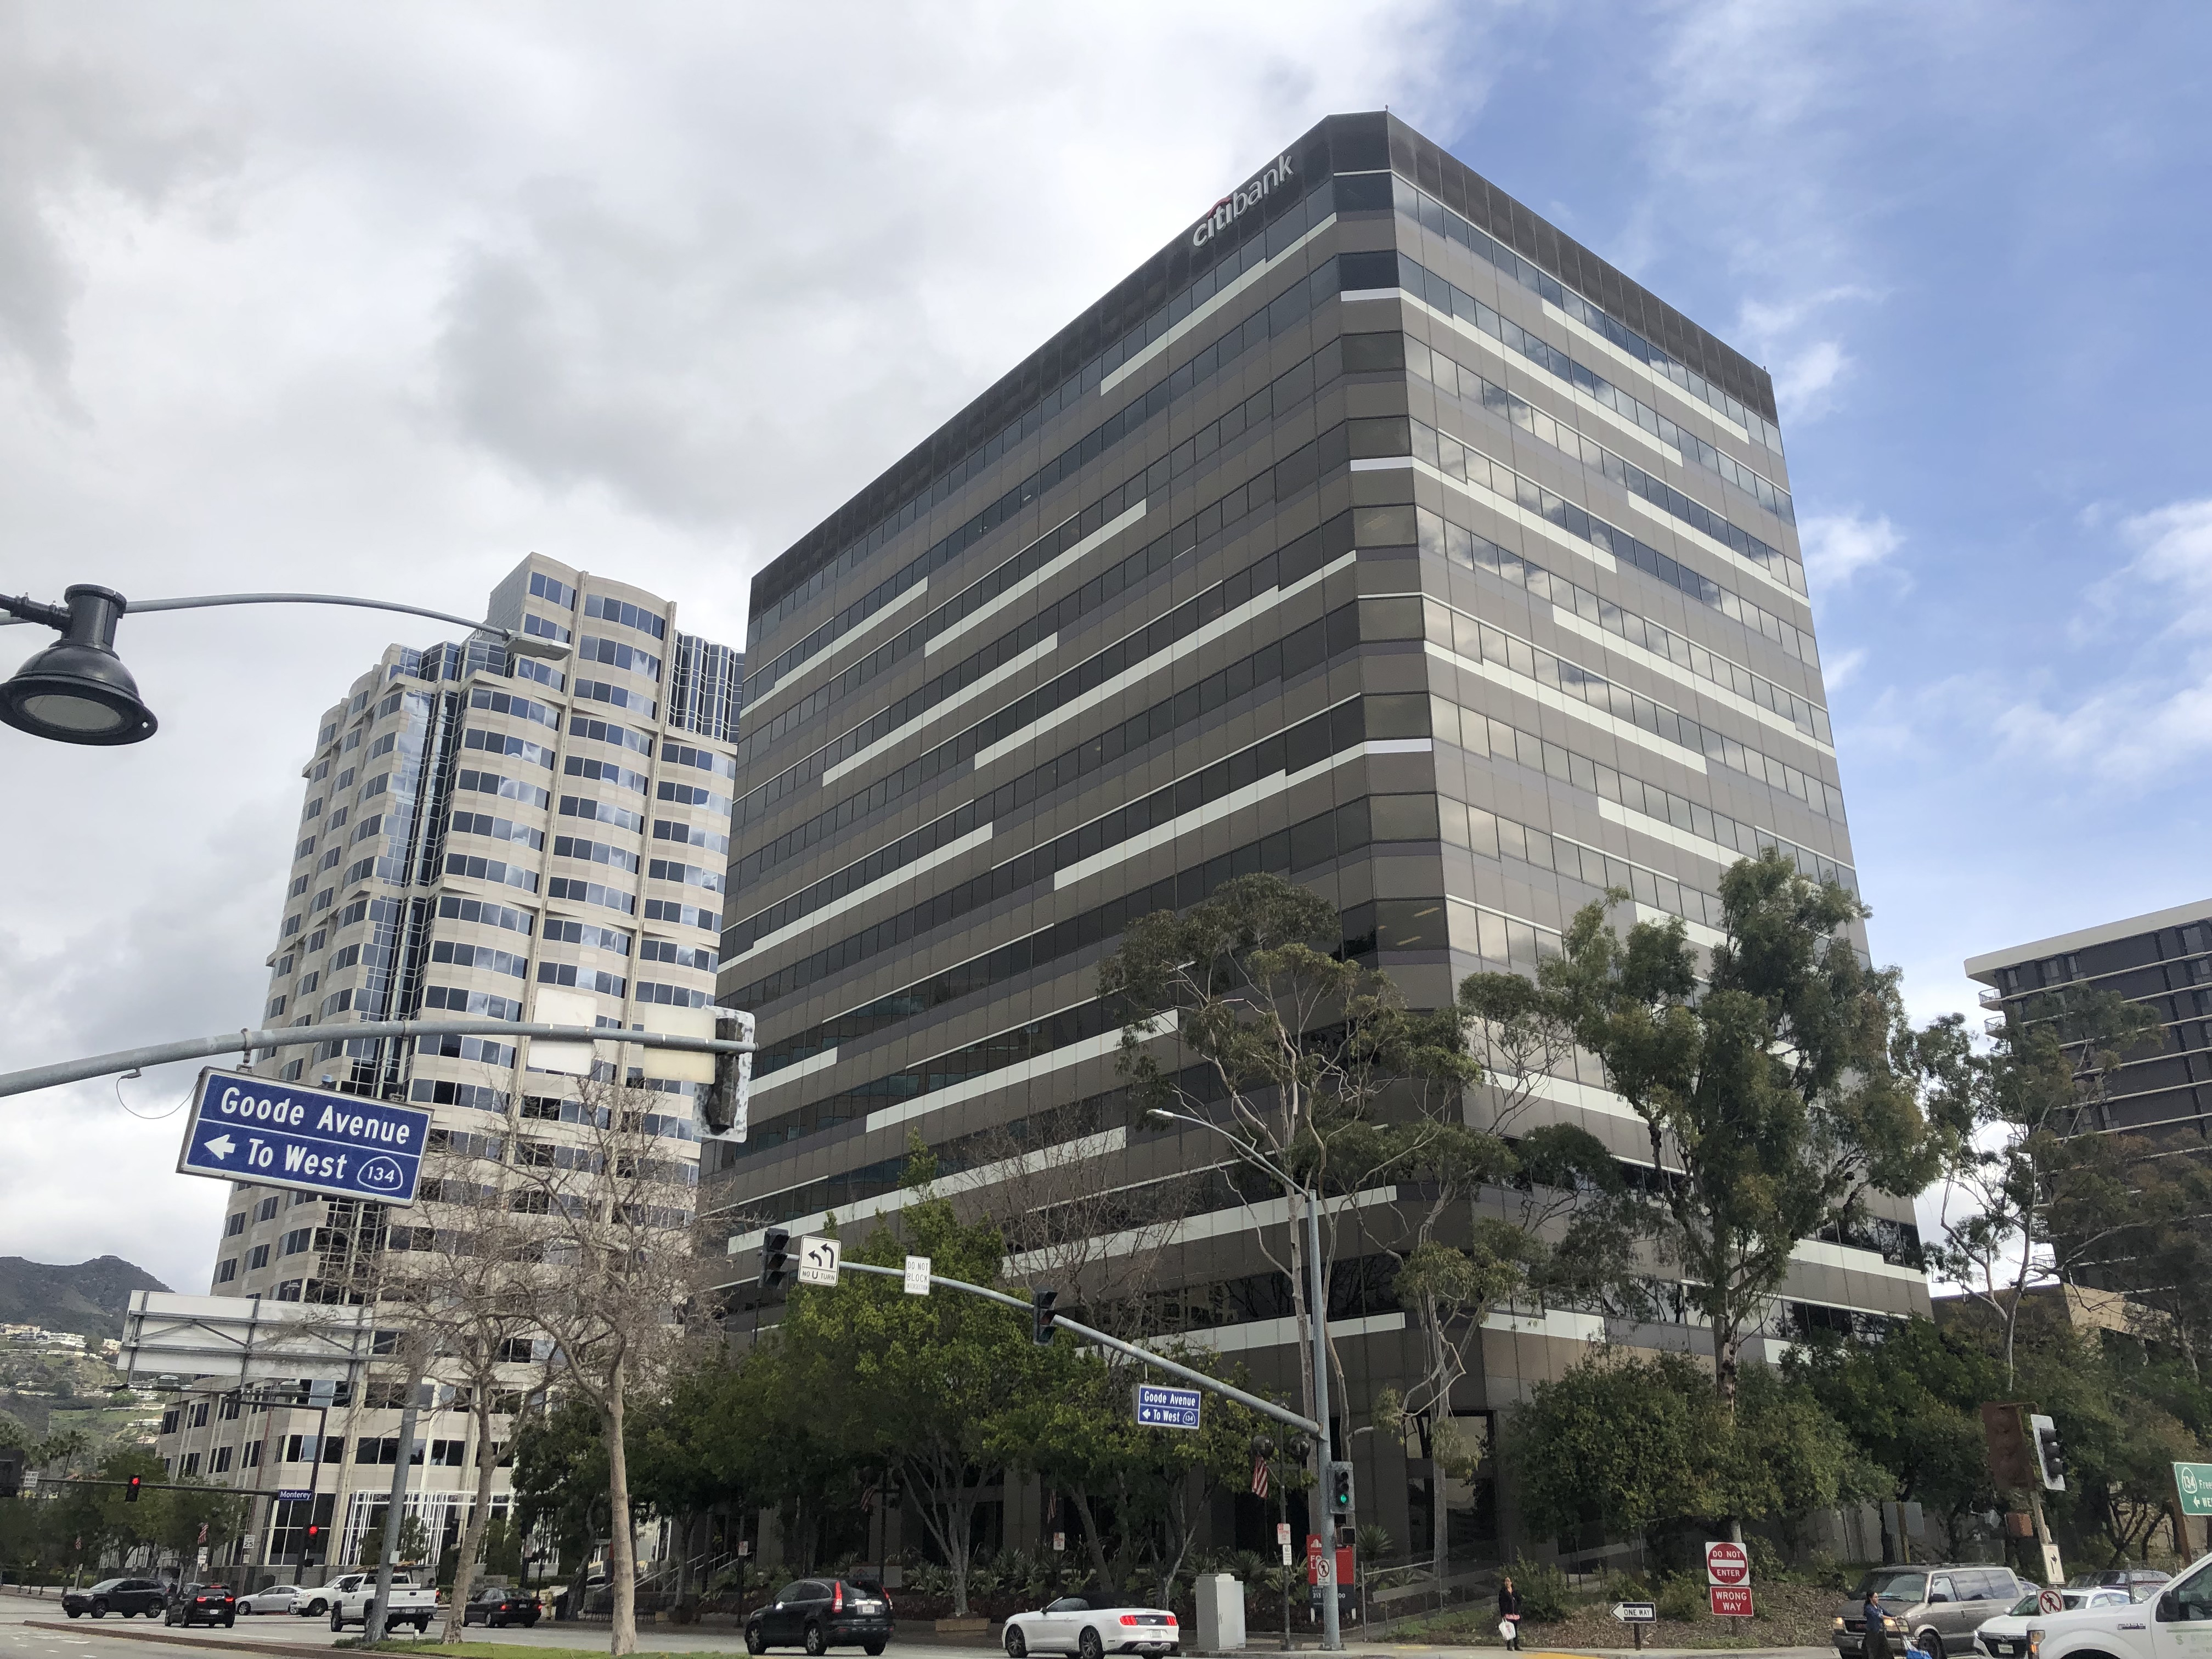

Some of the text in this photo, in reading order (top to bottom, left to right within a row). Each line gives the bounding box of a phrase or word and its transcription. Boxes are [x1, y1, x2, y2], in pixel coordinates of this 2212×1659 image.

[1193, 155, 1294, 247] citibank
[221, 1087, 410, 1144] Goode Avenue
[248, 1138, 395, 1183] To West 134
[907, 1261, 929, 1271] DO NOT
[812, 1270, 819, 1279] U
[821, 1273, 835, 1281] TURN
[907, 1273, 928, 1283] BLOCK
[1144, 1390, 1195, 1407] Goode Avenue
[1153, 1409, 1161, 1421] To
[1163, 1410, 1180, 1423] West
[2183, 1475, 2196, 1489] 134
[280, 1491, 312, 1500] Monterey
[2202, 1497, 2212, 1508] WE
[1716, 1591, 1747, 1601] WRONG
[1723, 1602, 1742, 1611] WAY
